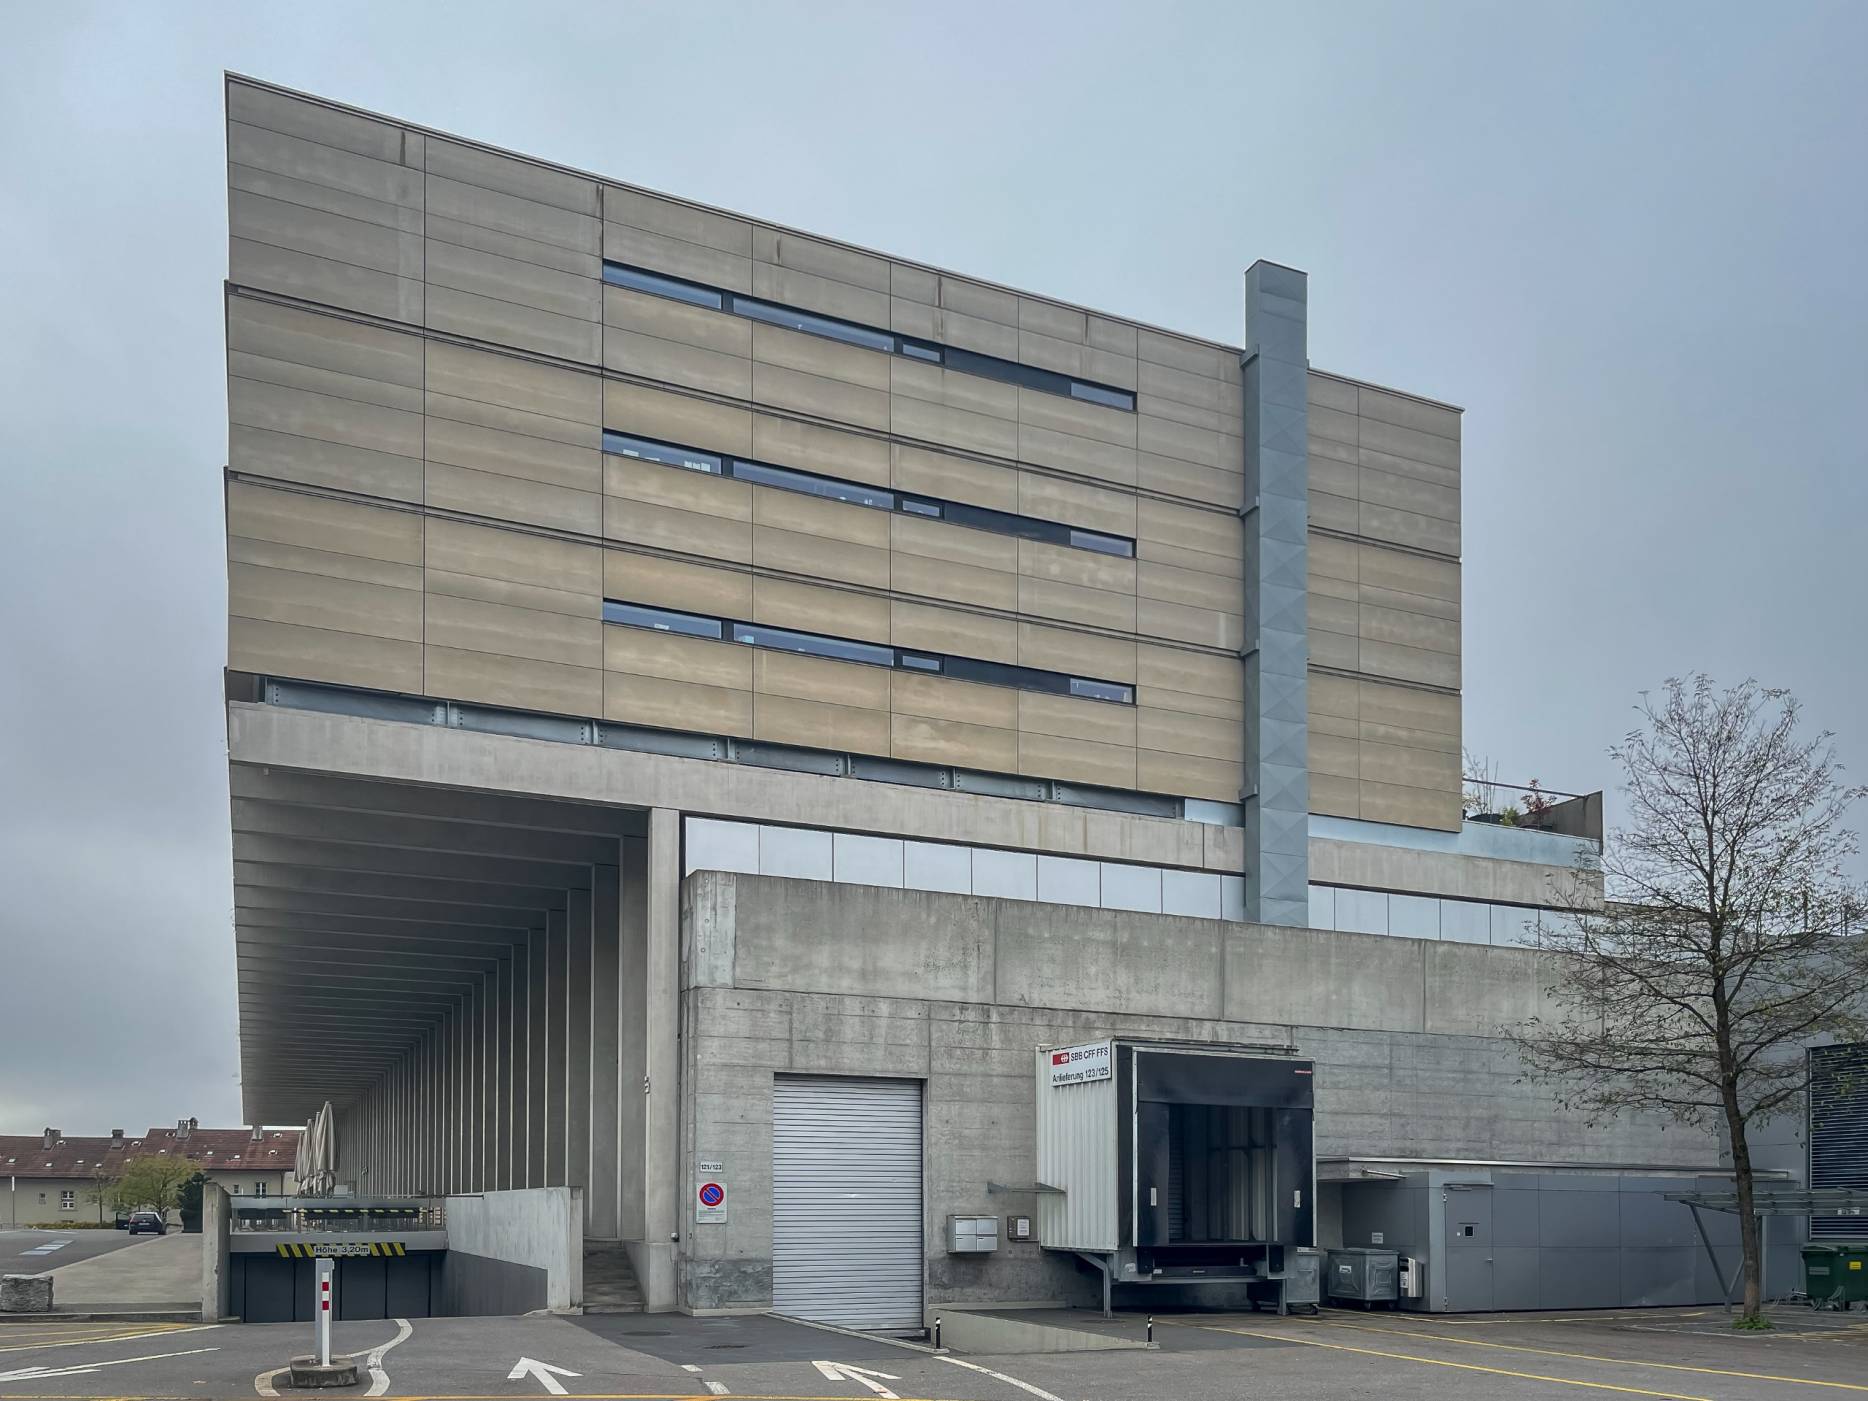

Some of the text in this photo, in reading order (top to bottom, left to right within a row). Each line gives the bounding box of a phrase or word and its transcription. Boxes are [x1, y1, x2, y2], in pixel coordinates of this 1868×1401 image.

[1070, 1047, 1109, 1062] SBB CFF FFS
[1052, 1067, 1109, 1083] Anlieferung 123/125
